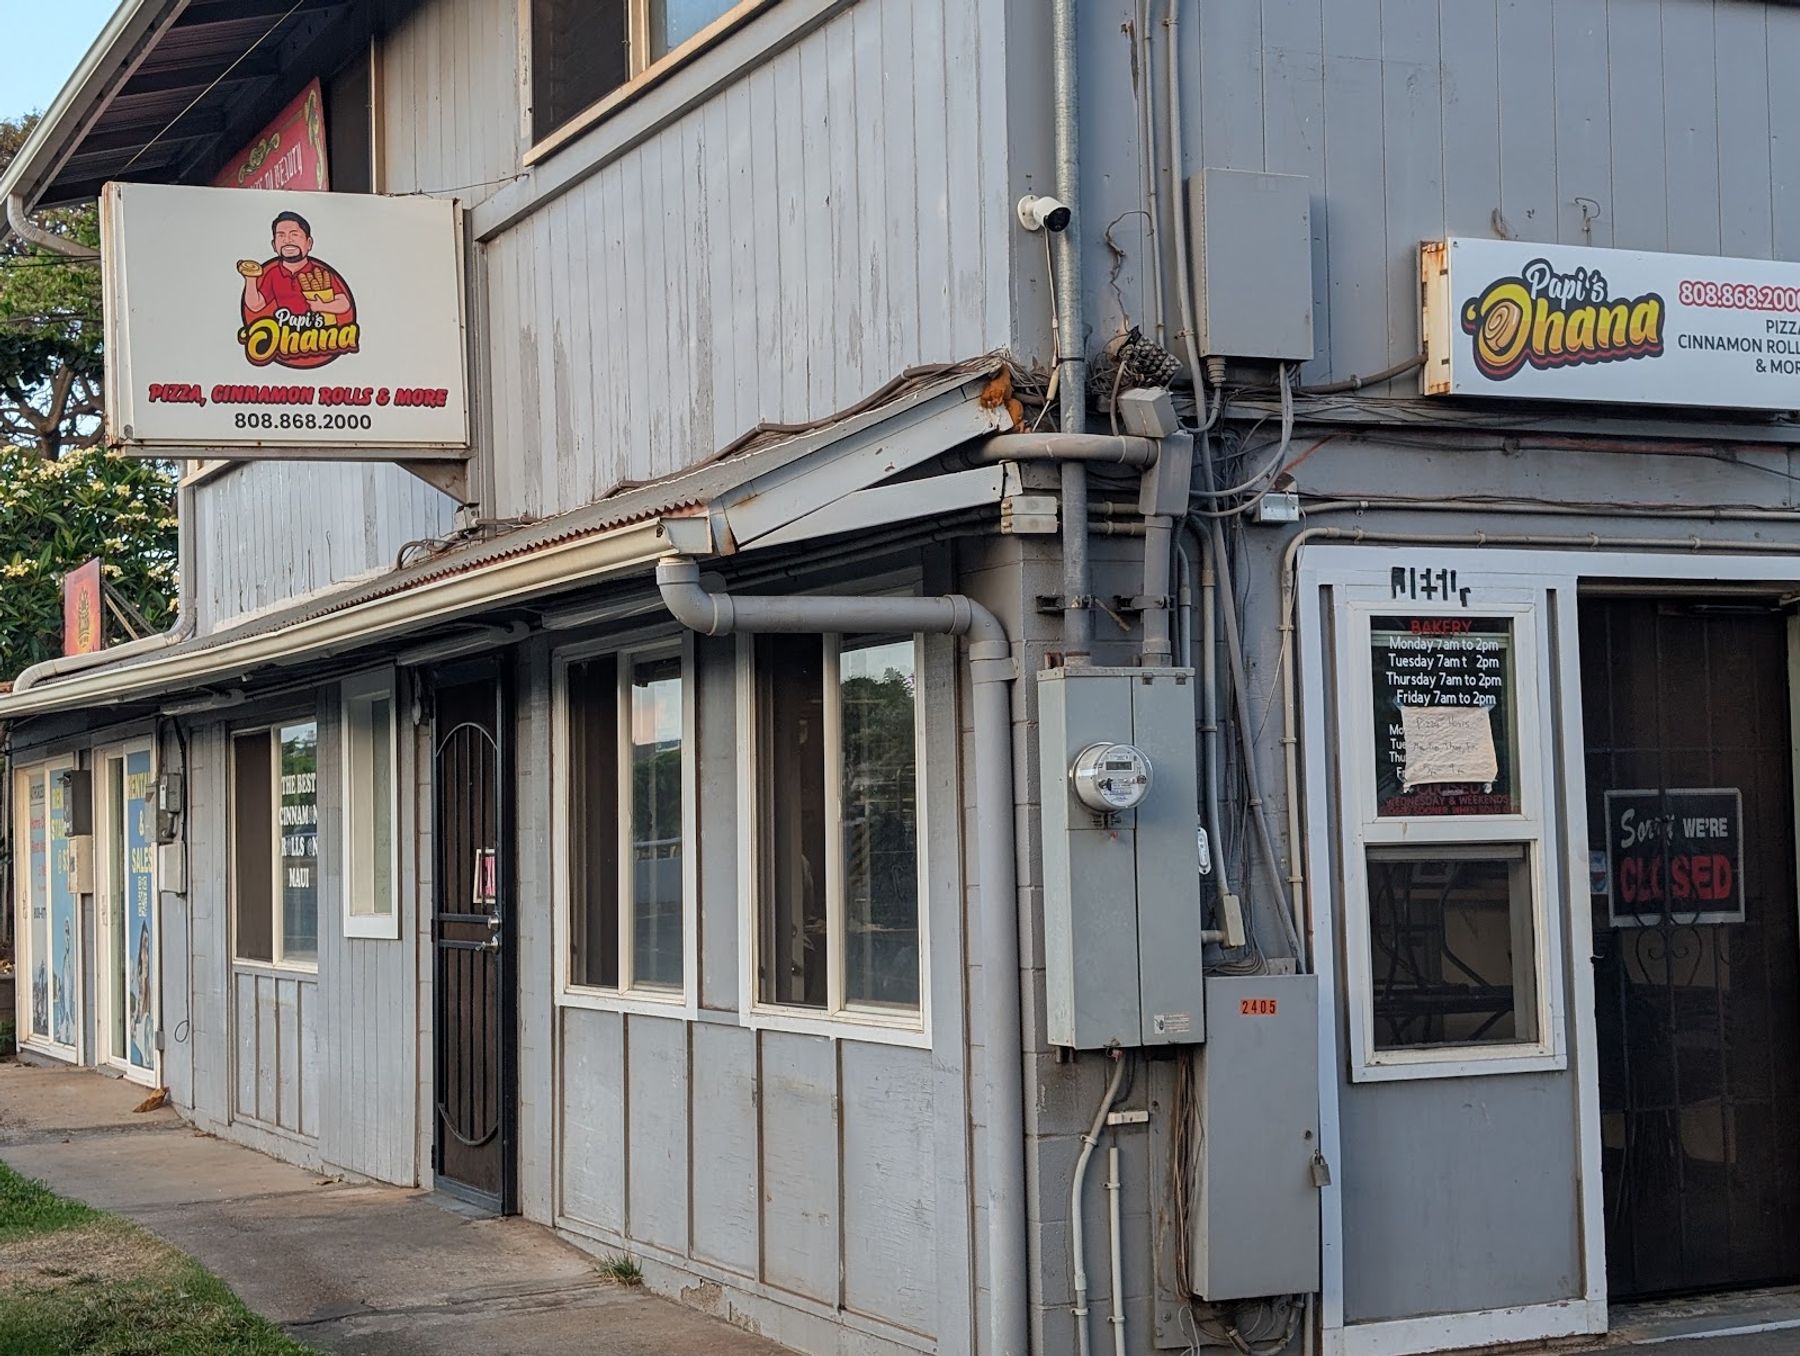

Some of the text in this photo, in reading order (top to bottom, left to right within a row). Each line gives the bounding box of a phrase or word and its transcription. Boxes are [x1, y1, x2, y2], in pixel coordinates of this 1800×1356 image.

[1525, 262, 1605, 311] Papi's
[275, 308, 324, 329] Papi's
[1765, 319, 1800, 336] PIZZ
[1677, 334, 1763, 353] CINNAMON
[1755, 358, 1767, 374] &
[149, 384, 448, 408] PIZZA, CINNAMON ROLLS & MORE
[234, 412, 372, 430] 808.868.2000
[1410, 620, 1472, 634] BAKERY
[1389, 636, 1499, 653] Monday 7am to 2pm
[1388, 653, 1434, 670] Tuesday
[1436, 654, 1460, 668] 7am
[1476, 655, 1500, 670] 2pm
[1386, 672, 1502, 689] Thursday 7am to 2pm
[1396, 690, 1496, 707] Friday 7am to 2pm
[281, 773, 316, 795] THE BEST
[1683, 817, 1729, 838] WE'RE
[289, 868, 310, 888] MAUI
[1242, 1000, 1276, 1015] 2405
